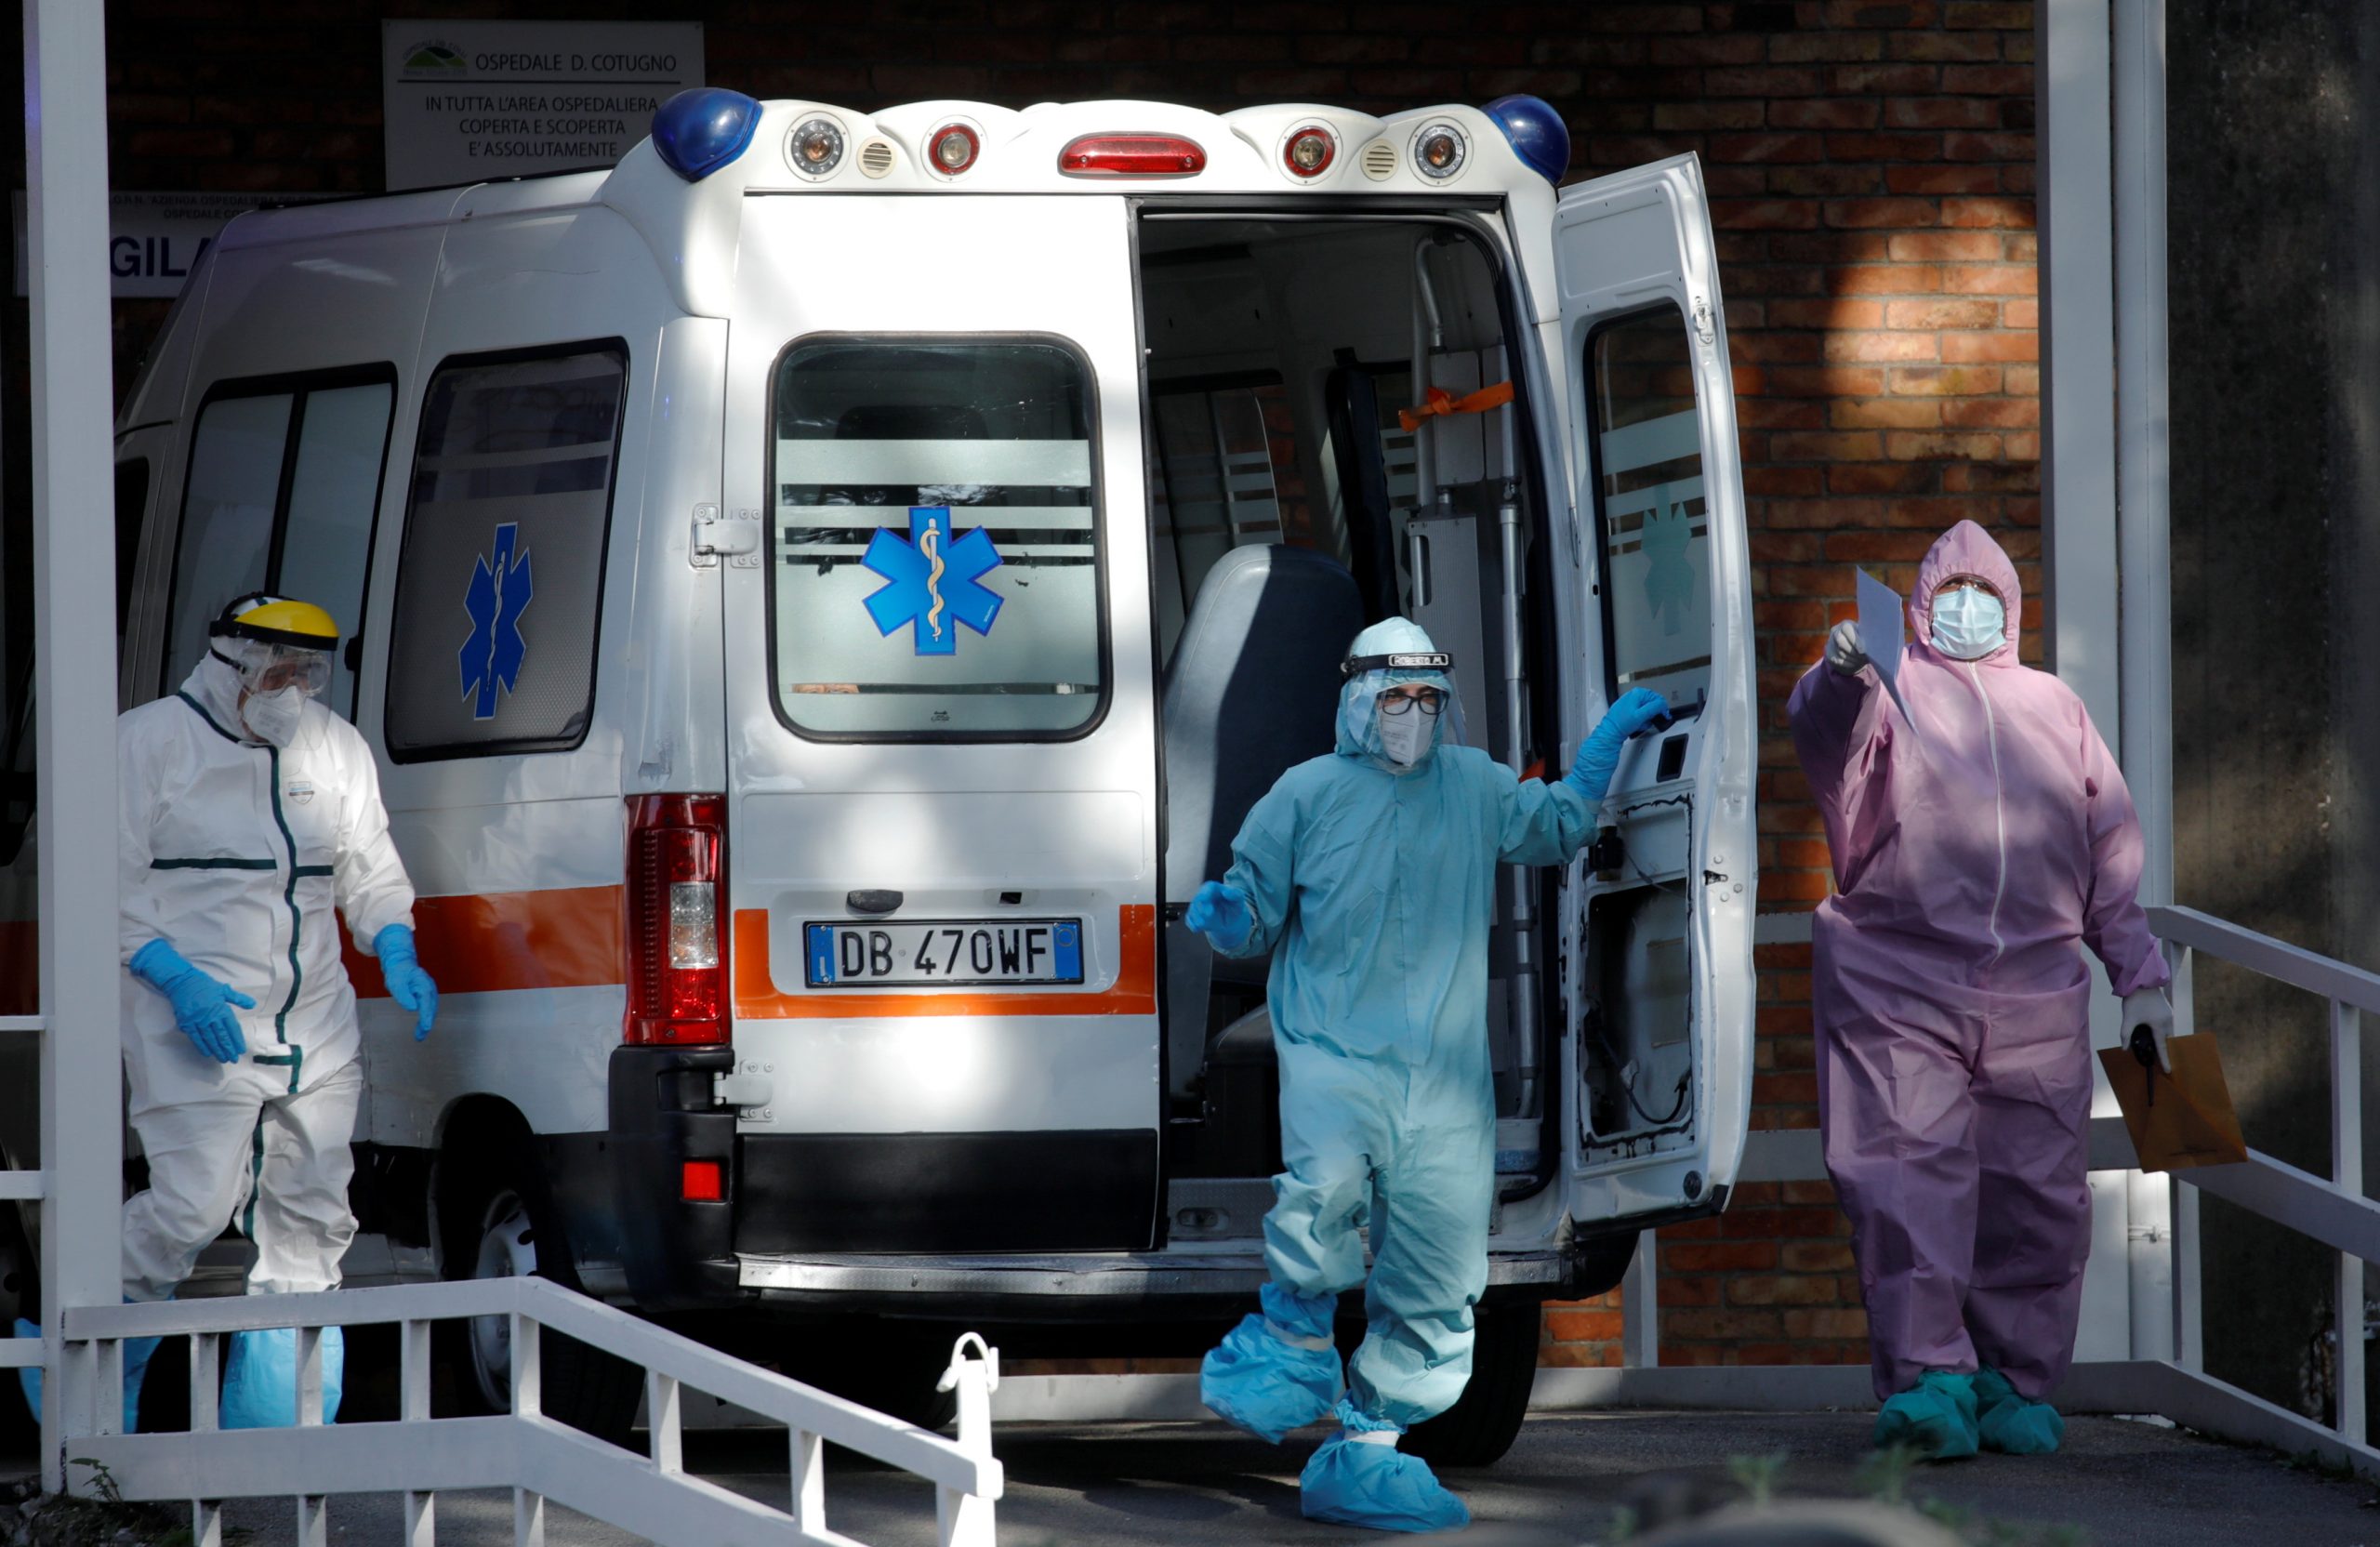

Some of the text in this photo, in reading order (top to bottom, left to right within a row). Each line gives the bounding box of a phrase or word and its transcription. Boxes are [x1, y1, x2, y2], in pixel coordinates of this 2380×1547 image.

[475, 55, 562, 72] OSPEDALE
[571, 55, 587, 72] D.
[591, 55, 677, 72] COTUGNO
[426, 96, 658, 112] IN TUTTA L'AREA OSPEDALIERA
[459, 119, 626, 134] COPERTA E SCOPERTA
[469, 141, 617, 157] E' ASSOLUTAMENTE
[163, 209, 221, 219] OSPEDALE
[840, 928, 1048, 977] DB 470WF
